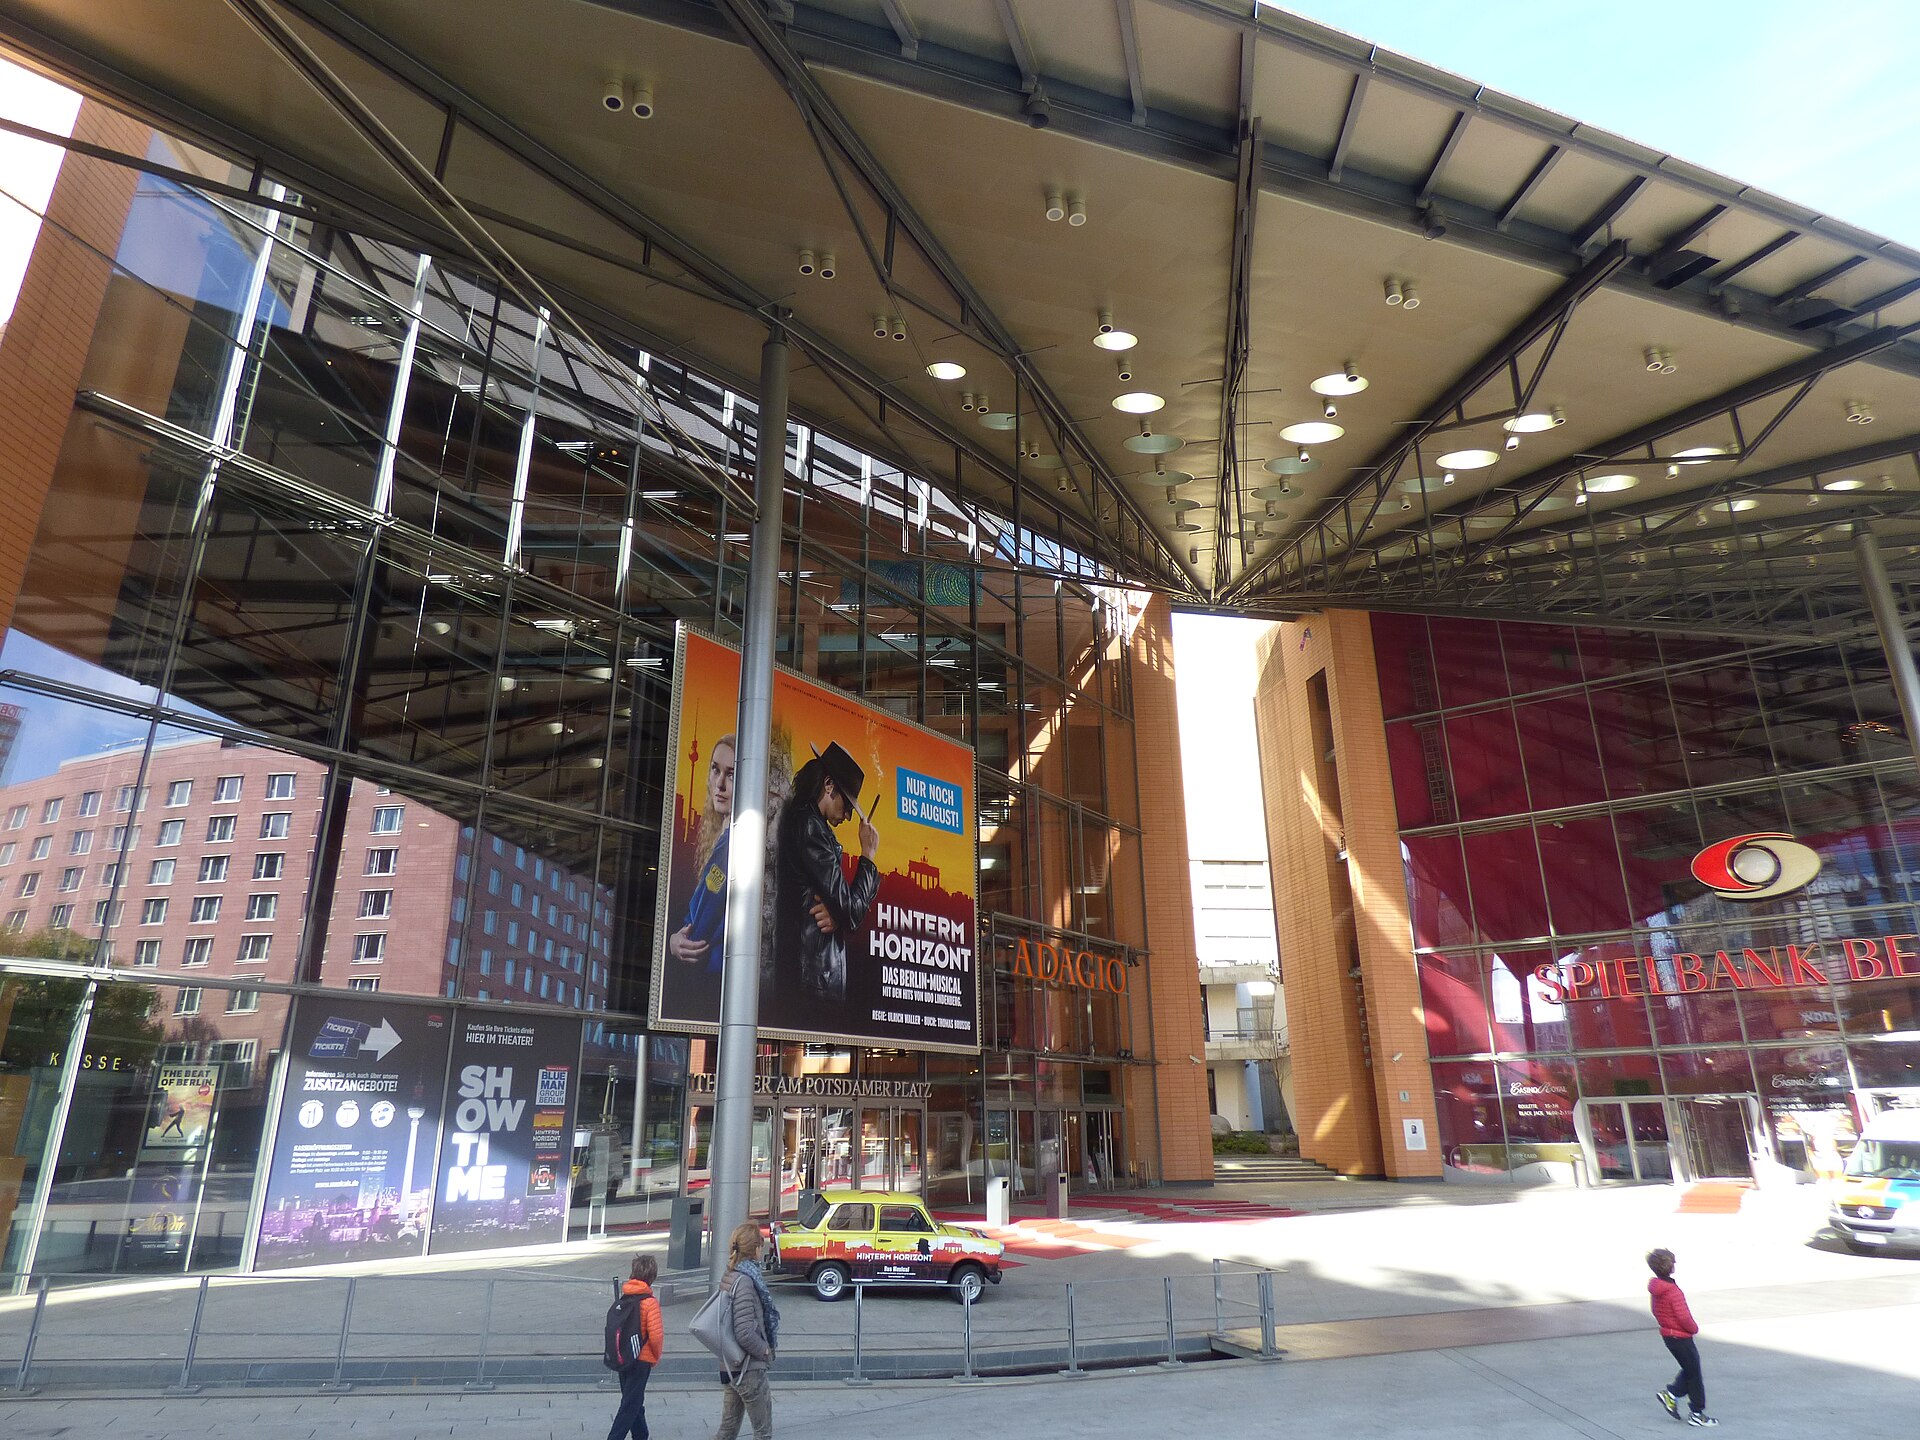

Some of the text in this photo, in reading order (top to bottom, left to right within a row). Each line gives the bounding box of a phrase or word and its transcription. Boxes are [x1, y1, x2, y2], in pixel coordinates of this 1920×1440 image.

[906, 776, 954, 807] NUR NOCH
[901, 796, 959, 828] BIS AUGUST!
[877, 902, 965, 945] HINTERM
[869, 930, 971, 973] HORIZONT
[1013, 938, 1127, 993] ADAGIO
[1534, 933, 1920, 1004] SPIELBANK BE
[882, 965, 898, 987] DAS
[882, 986, 893, 998] MIT
[326, 1022, 355, 1035] TICKETS
[467, 1023, 485, 1032] Kaufen
[493, 1025, 504, 1033] Ihre
[504, 1026, 521, 1034] Tickets
[314, 1042, 345, 1051] TICKETS
[466, 1032, 534, 1046] HIER IM THEATER!
[49, 1052, 122, 1070] KSSE
[163, 1070, 211, 1078] THE BEAT
[457, 1065, 513, 1098] SH
[541, 1071, 566, 1081] BLUE
[303, 1078, 398, 1092] ZUSATZANGEBOTE!
[540, 1080, 565, 1091] MAN
[776, 1075, 803, 1095] AM
[804, 1077, 893, 1098] POTSDAMER
[894, 1081, 932, 1099] PLATZ
[538, 1096, 564, 1104] BERLIN
[456, 1098, 526, 1131] OW
[452, 1132, 490, 1167] TI
[446, 1165, 507, 1202] ME
[856, 1251, 934, 1263] HINTERM HORIZONT
